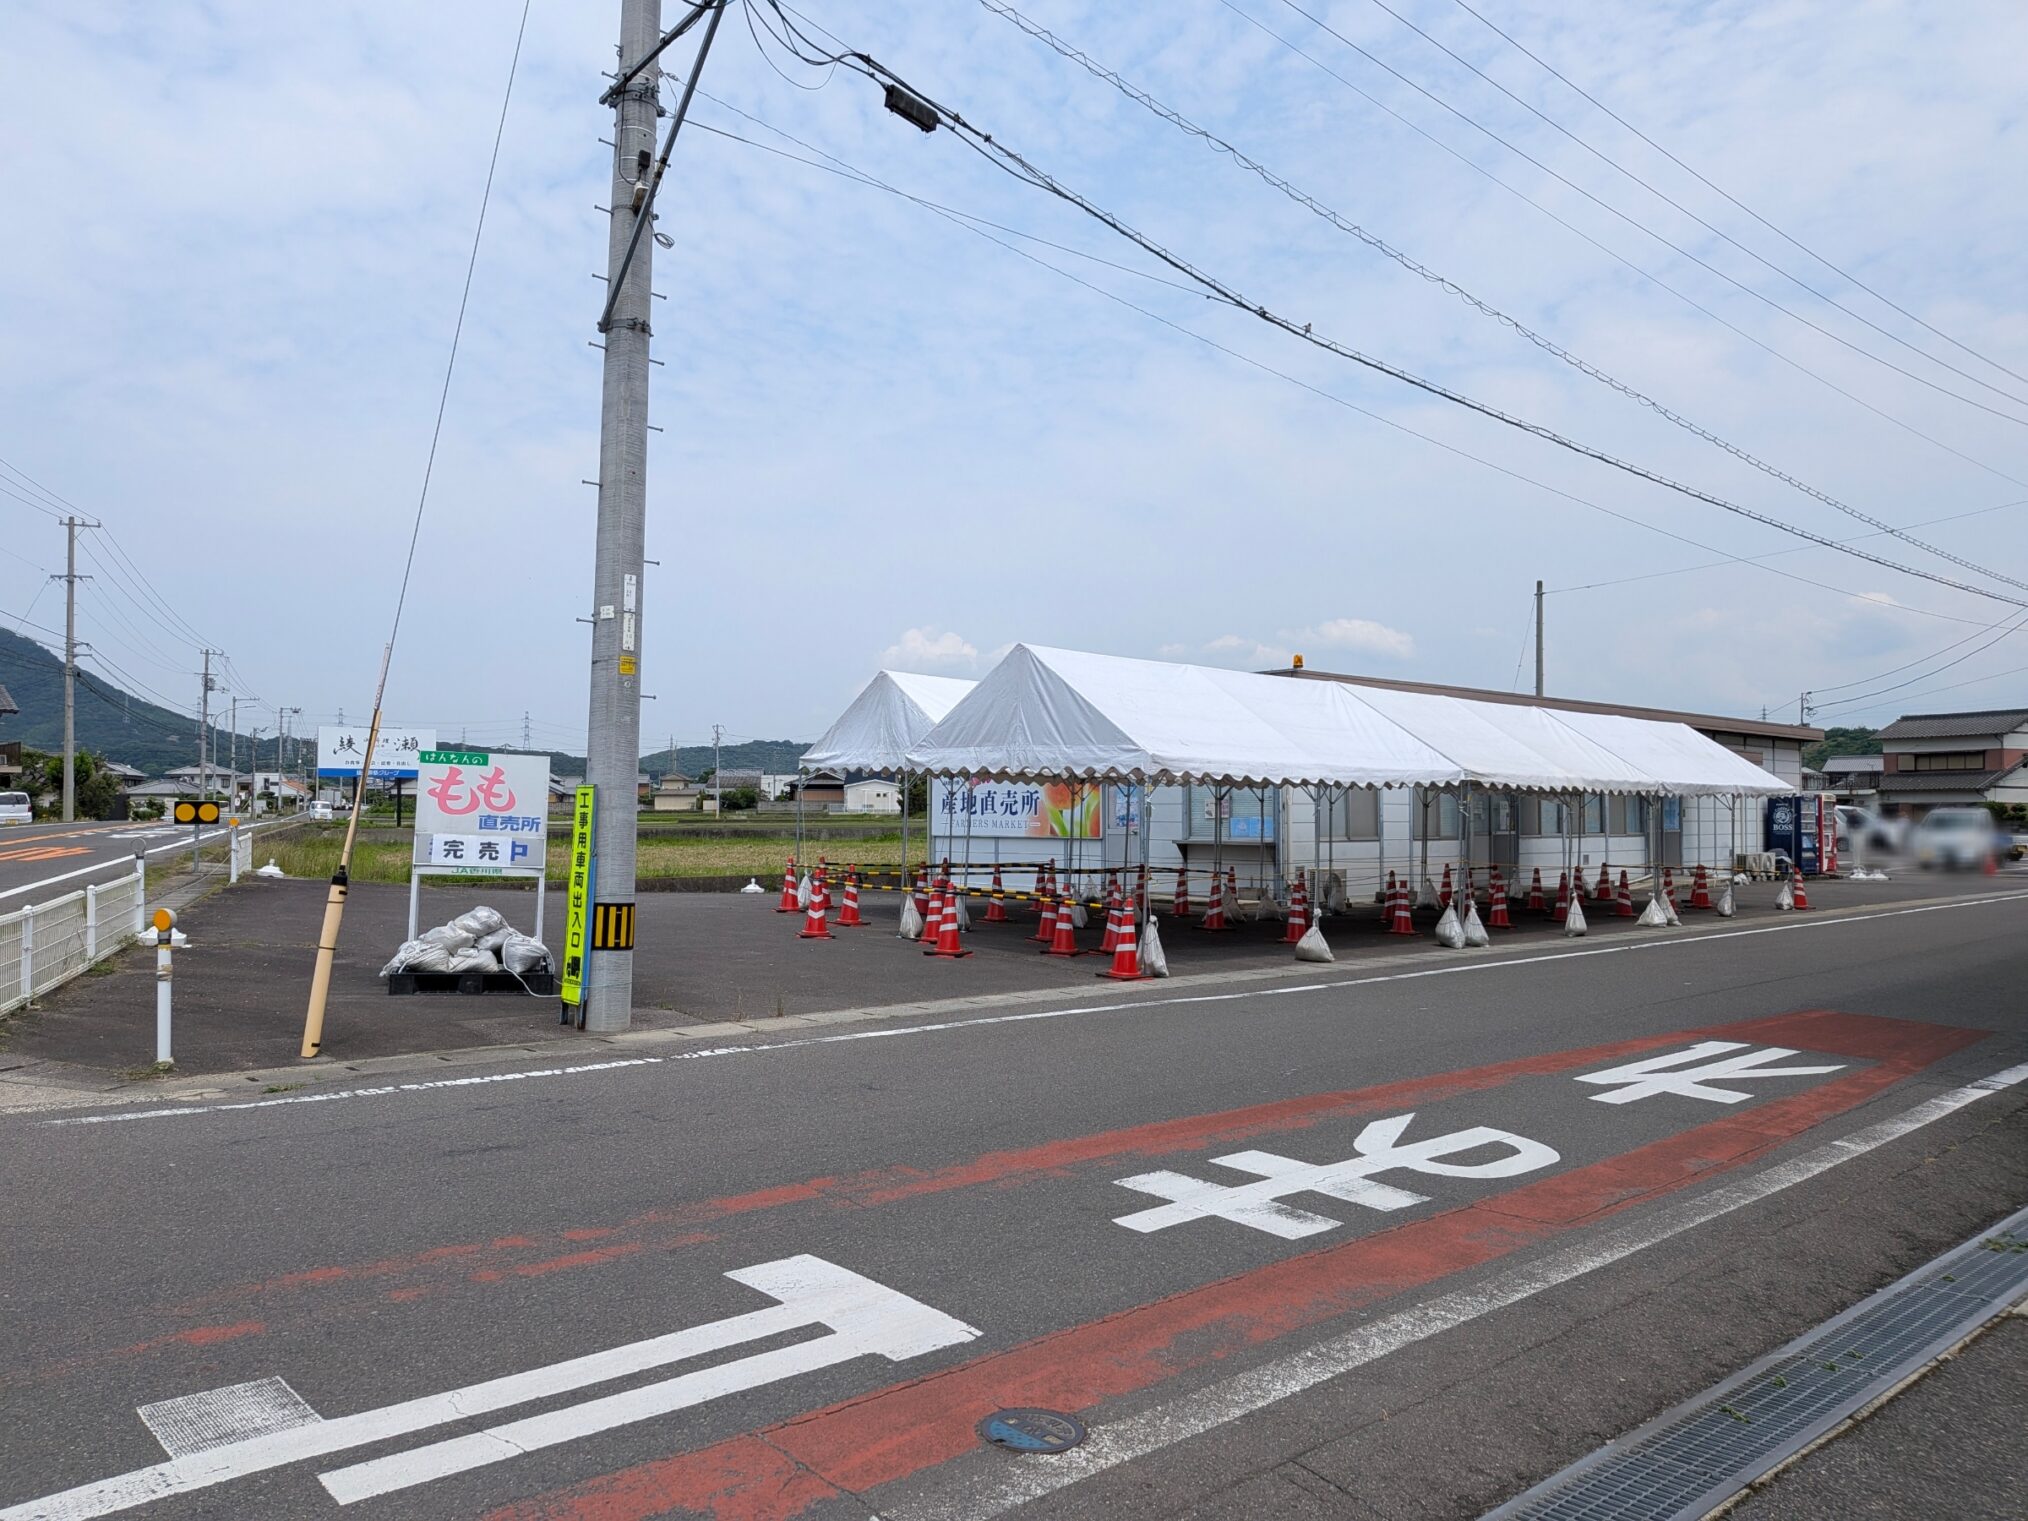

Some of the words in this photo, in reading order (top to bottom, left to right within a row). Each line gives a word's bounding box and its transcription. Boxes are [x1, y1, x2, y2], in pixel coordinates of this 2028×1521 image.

[425, 752, 483, 765] はんなんの
[427, 766, 516, 815] もも
[940, 789, 1041, 816] 産地直売所
[478, 815, 541, 832] 直売所
[991, 819, 1028, 829] MARKET
[443, 840, 500, 861] 完売
[571, 792, 590, 949] 工事用車両出入口
